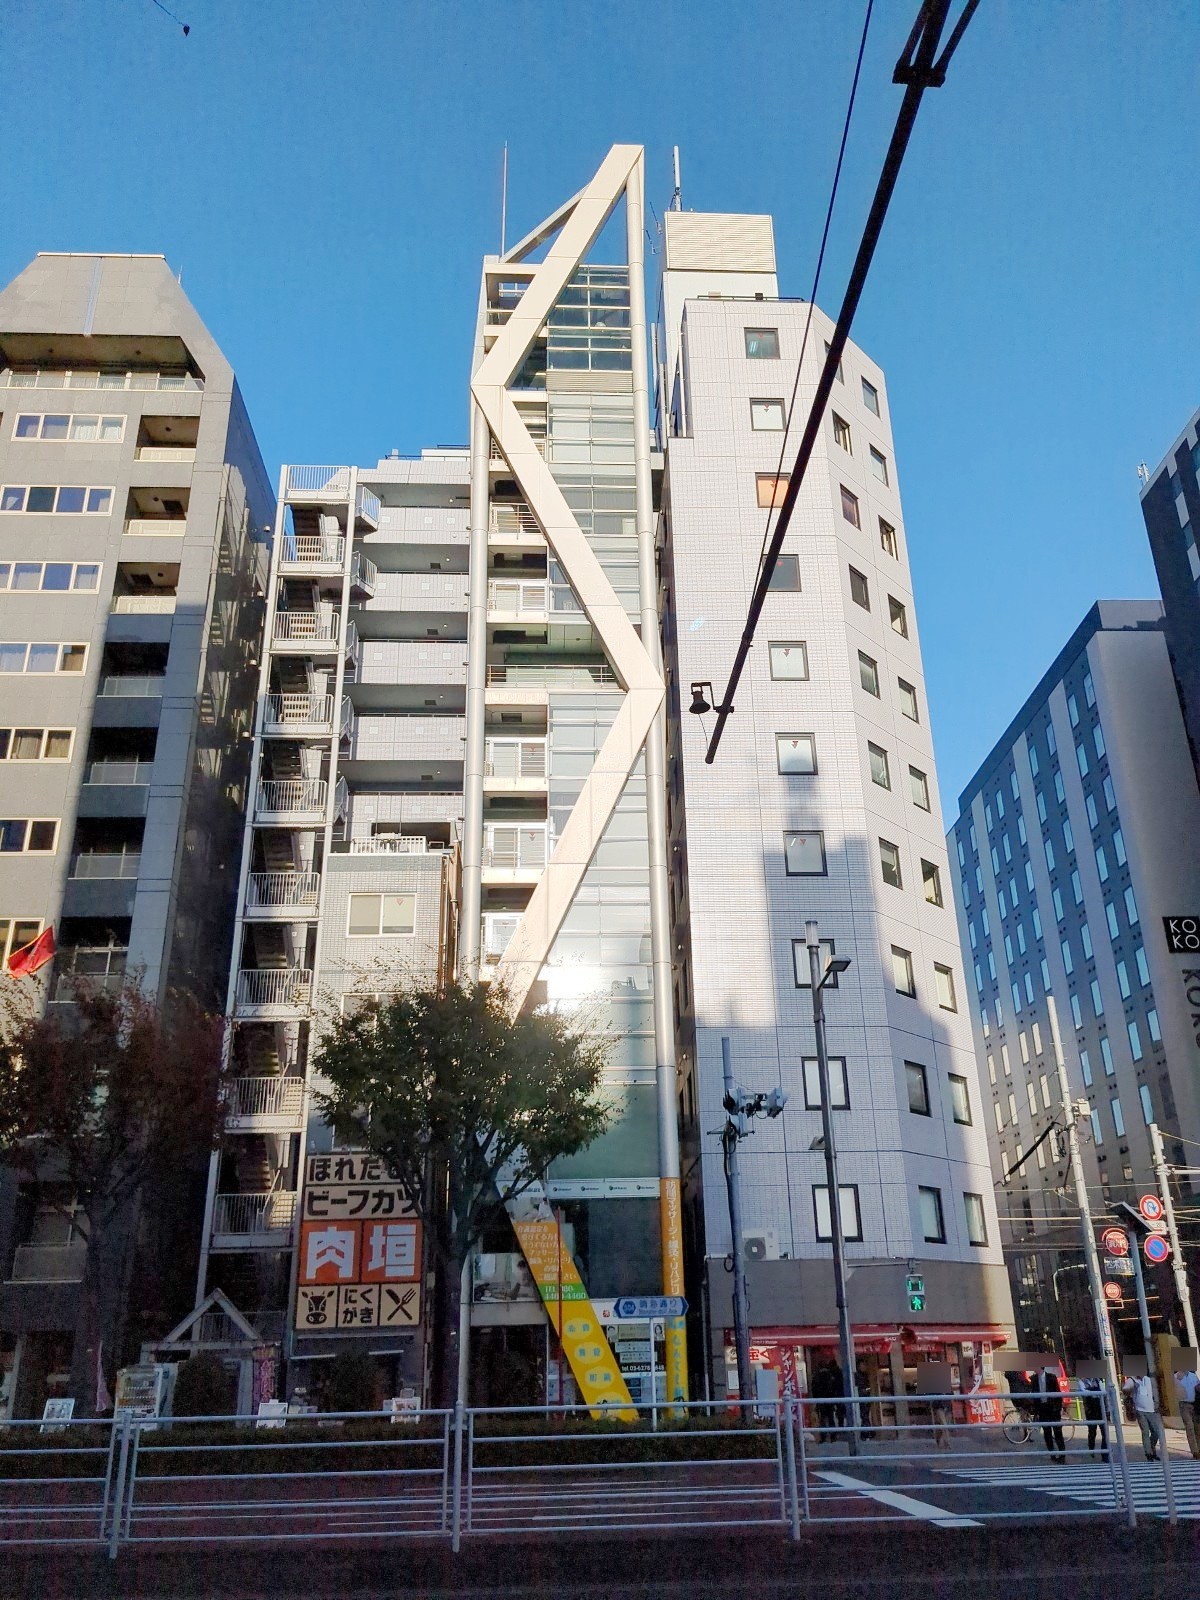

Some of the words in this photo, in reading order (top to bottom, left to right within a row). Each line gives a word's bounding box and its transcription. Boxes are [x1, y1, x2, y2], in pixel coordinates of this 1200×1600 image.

[1169, 919, 1197, 934] KO
[1172, 934, 1200, 949] KO
[306, 1189, 421, 1216] ビーフカツ
[305, 1224, 417, 1280] 肉垣
[343, 1288, 374, 1305] にく
[342, 1307, 375, 1325] がき
